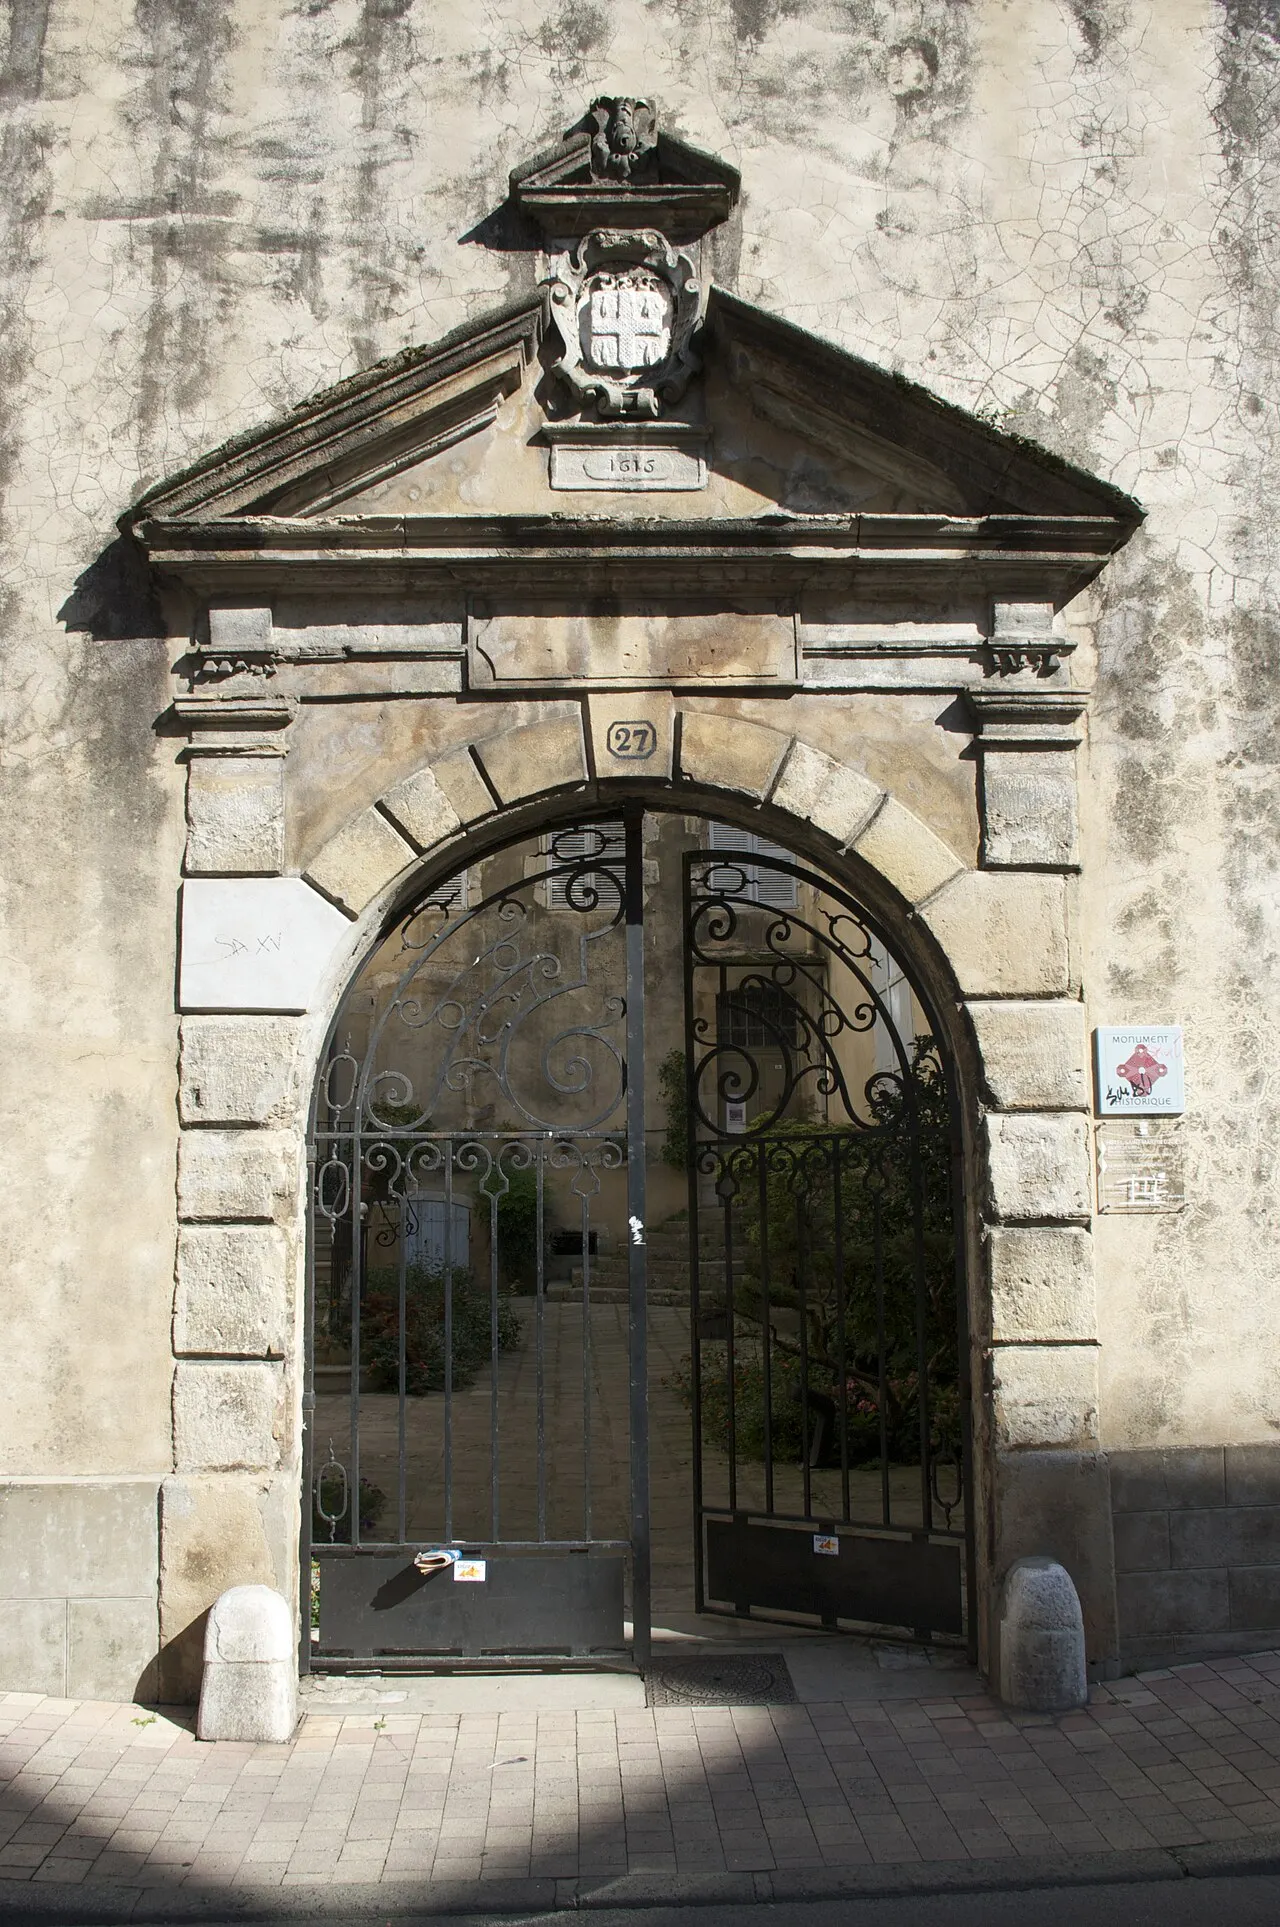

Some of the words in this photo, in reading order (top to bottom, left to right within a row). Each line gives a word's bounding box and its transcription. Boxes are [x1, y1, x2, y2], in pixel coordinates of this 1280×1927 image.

[615, 728, 649, 752] 27
[1112, 1035, 1169, 1044] MONUMENT
[1115, 1097, 1172, 1107] HISTORIQUE
